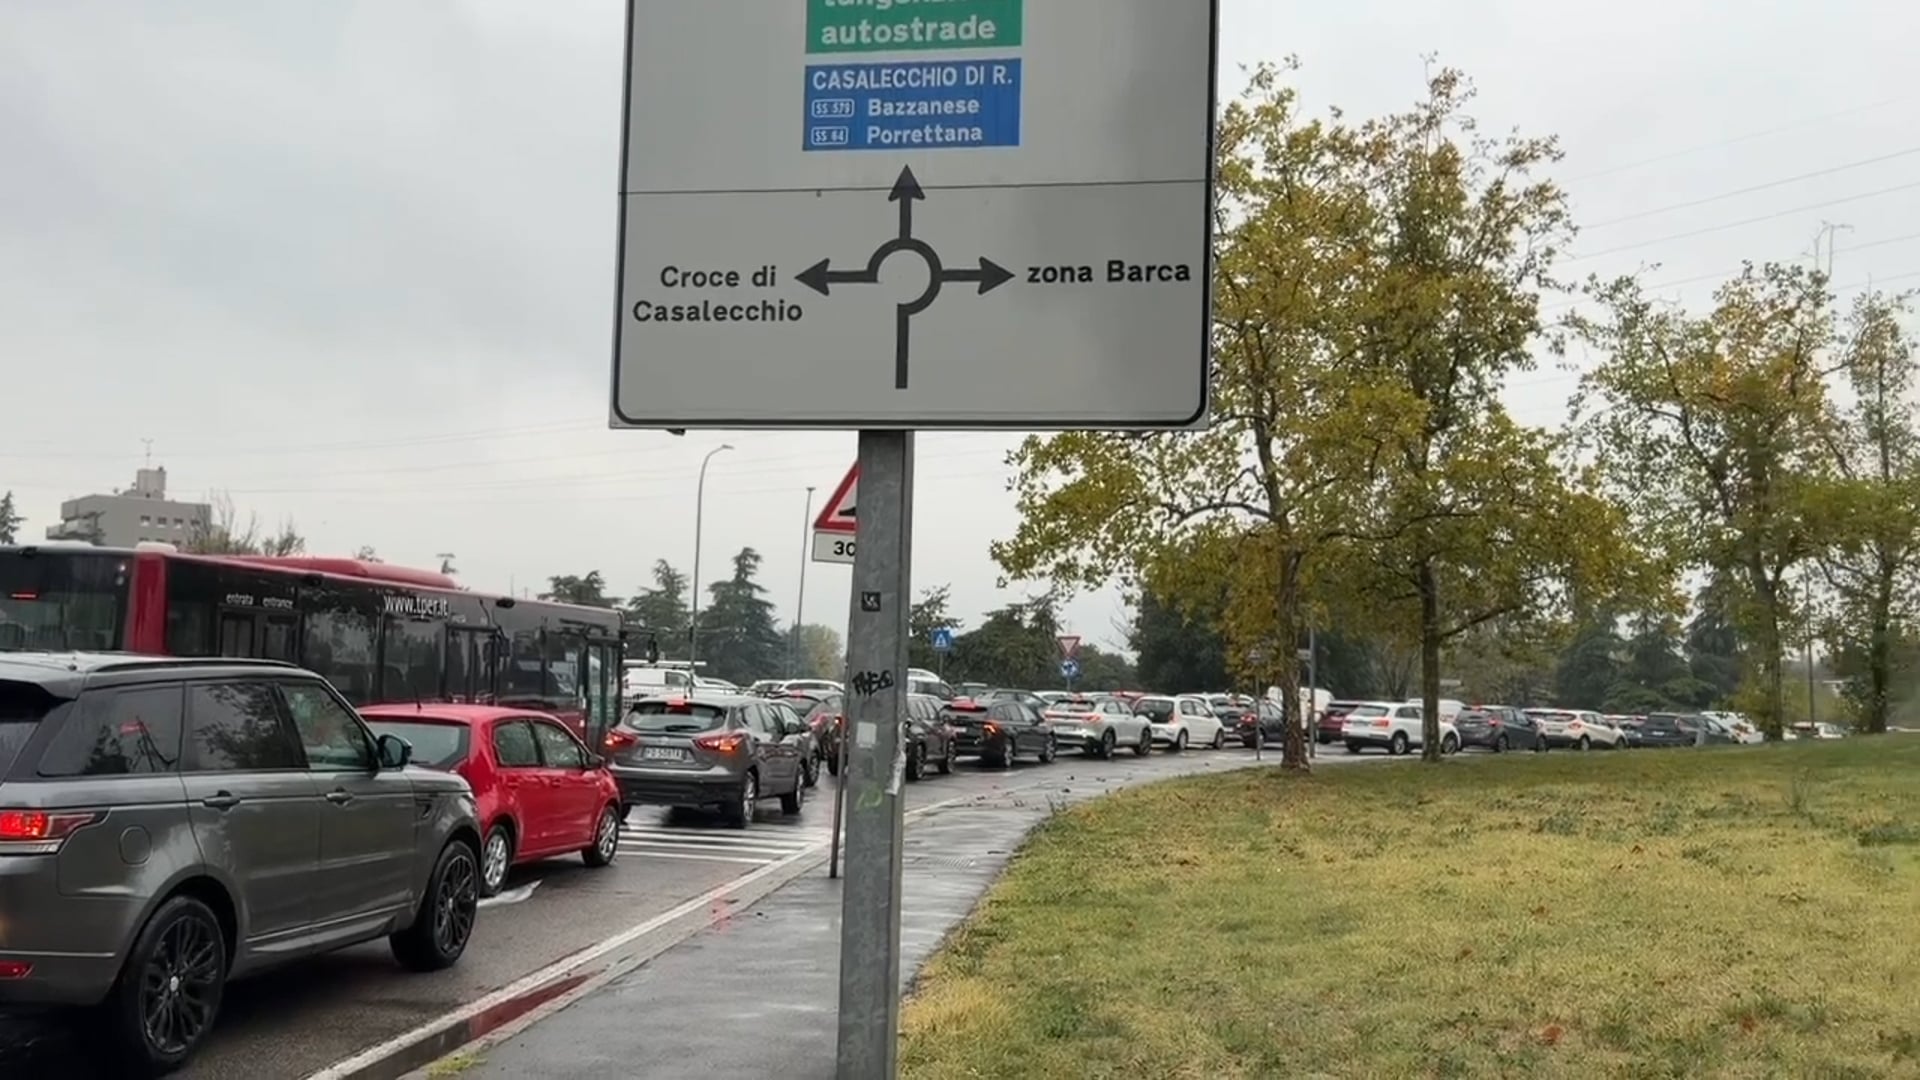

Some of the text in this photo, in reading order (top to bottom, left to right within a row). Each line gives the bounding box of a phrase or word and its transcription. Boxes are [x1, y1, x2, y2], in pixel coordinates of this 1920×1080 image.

[821, 15, 996, 44] autostrade
[812, 65, 1013, 90] CASALECCHIO DI R.
[815, 102, 829, 115] SS
[868, 98, 980, 116] Bazzanese
[815, 129, 845, 142] SS 64
[867, 125, 983, 144] Porrettana
[660, 265, 776, 288] Croce di
[1027, 260, 1191, 283] zona Barca
[632, 299, 803, 322] Casalecchio
[833, 540, 856, 557] 30
[383, 595, 448, 620] www.tper.it
